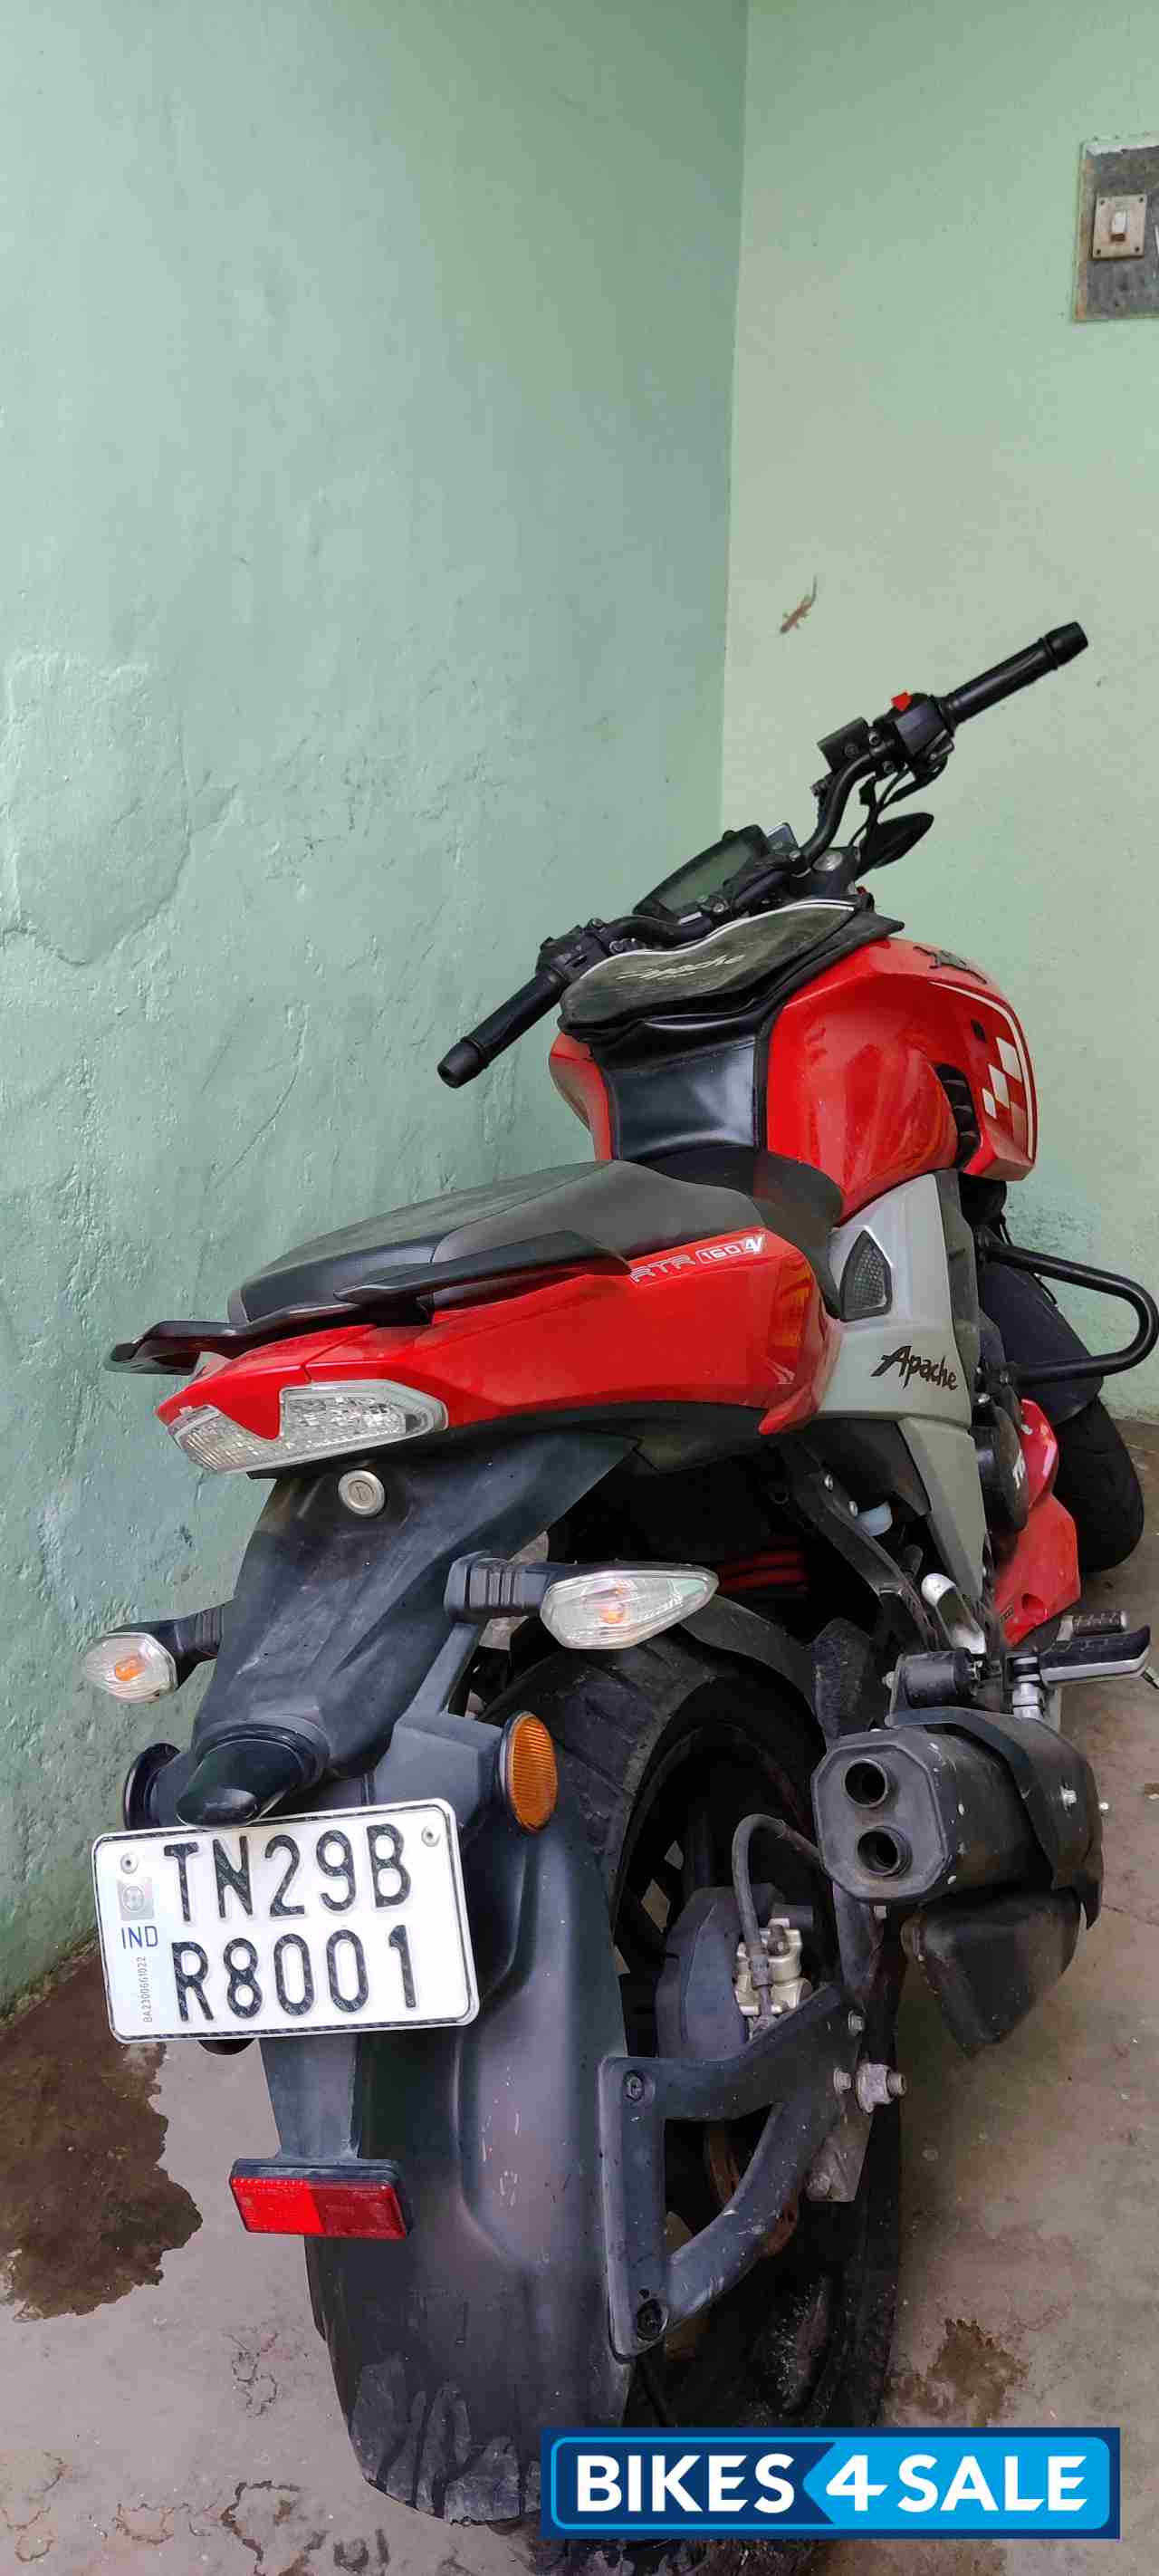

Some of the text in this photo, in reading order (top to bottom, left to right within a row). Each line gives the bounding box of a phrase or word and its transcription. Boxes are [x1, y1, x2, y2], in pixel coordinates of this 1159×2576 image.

[629, 1254, 696, 1283] RTR
[870, 1345, 959, 1390] Apache
[163, 1823, 411, 1922] TN29B
[121, 1926, 158, 1949] IND
[171, 1925, 417, 2022] R8001
